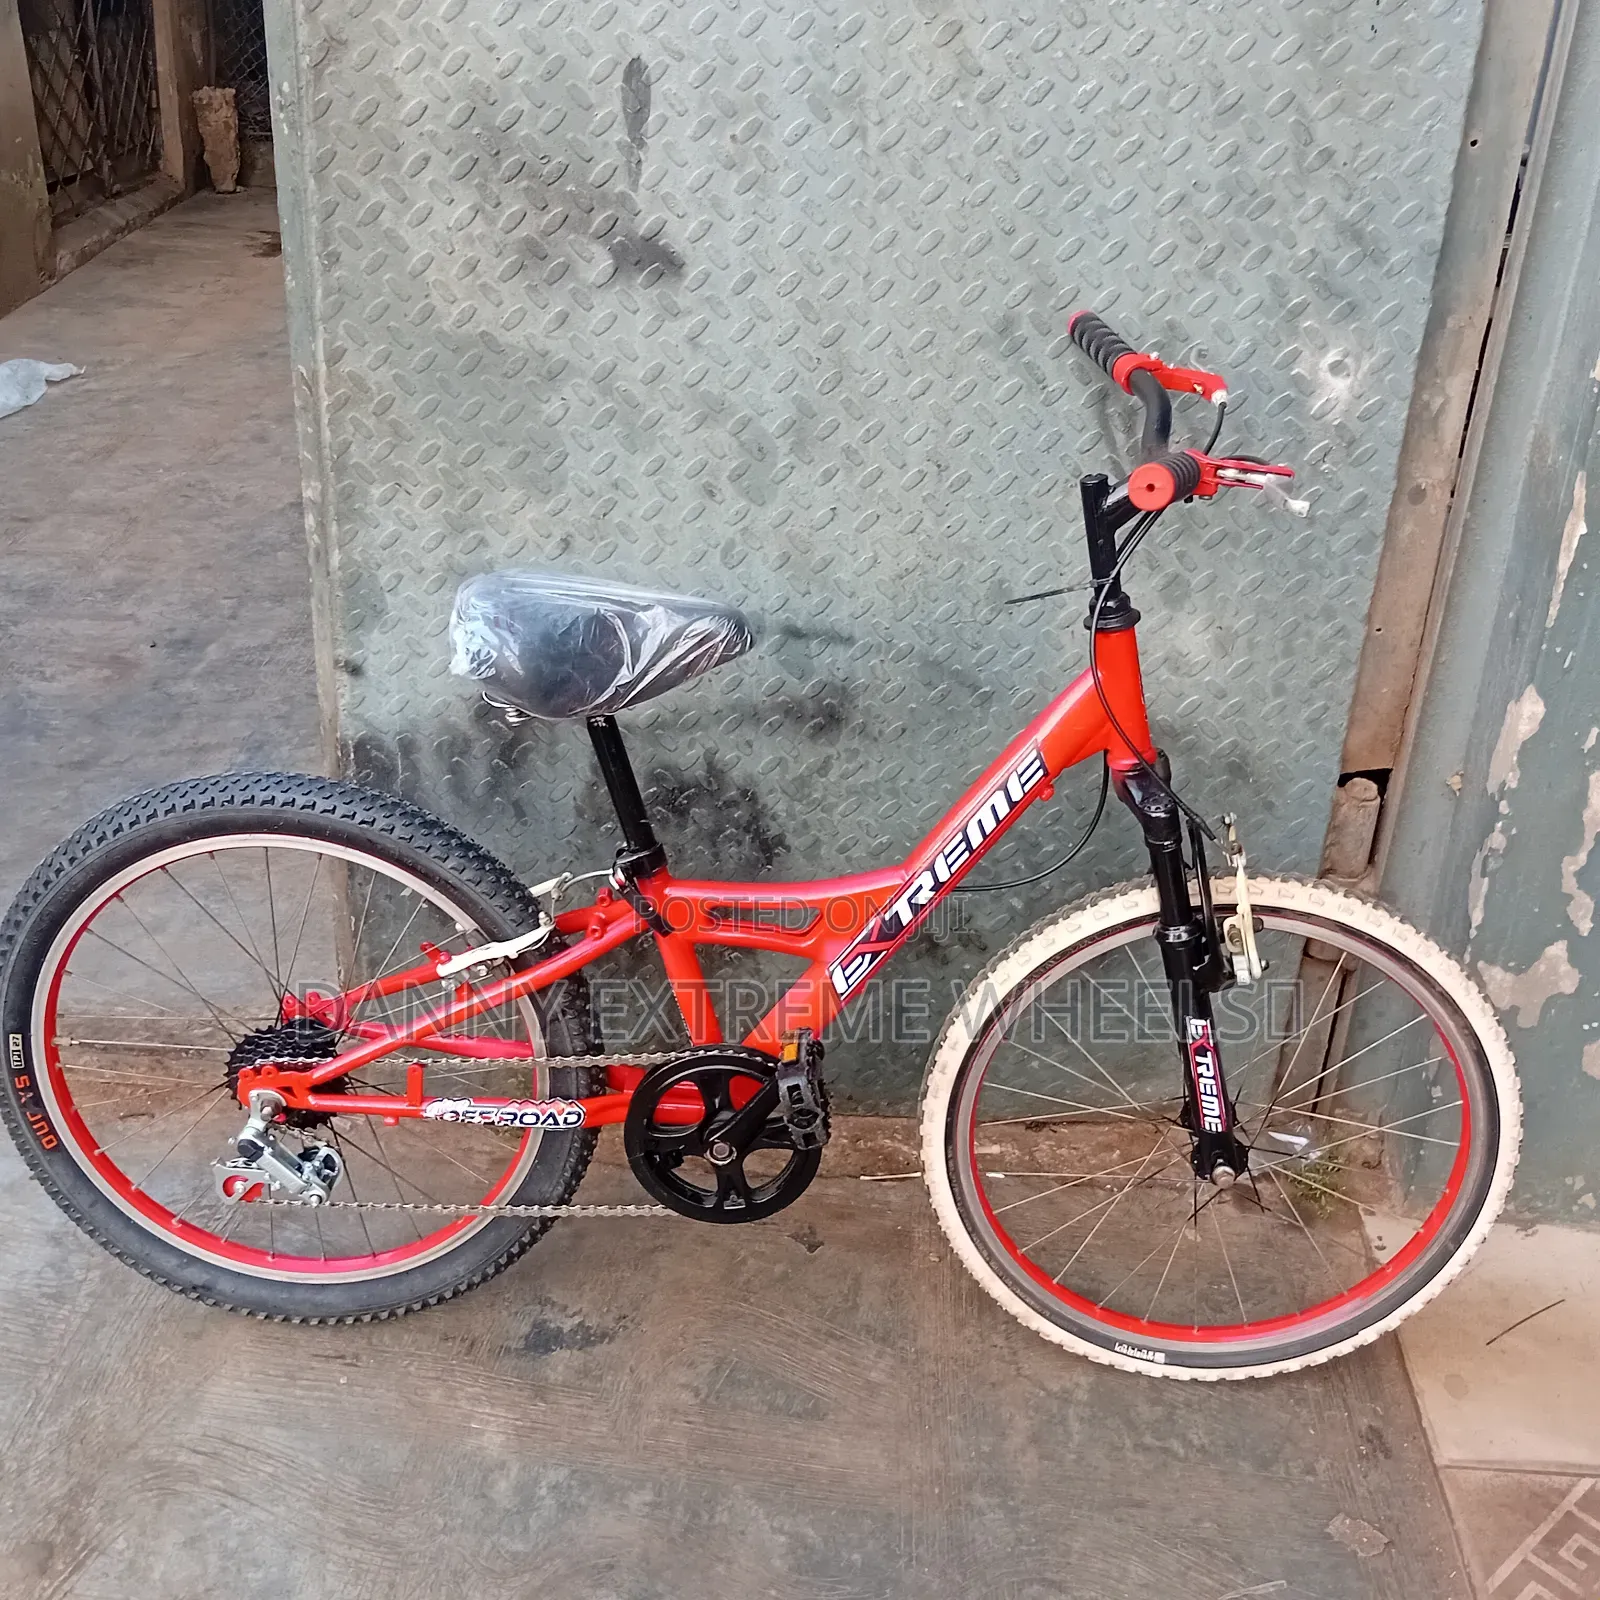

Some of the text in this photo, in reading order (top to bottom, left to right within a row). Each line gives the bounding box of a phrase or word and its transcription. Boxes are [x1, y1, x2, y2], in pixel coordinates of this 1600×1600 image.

[830, 747, 1046, 996] EXTREME
[12, 1036, 23, 1067] TPI 27
[1189, 1018, 1223, 1133] EXTREME
